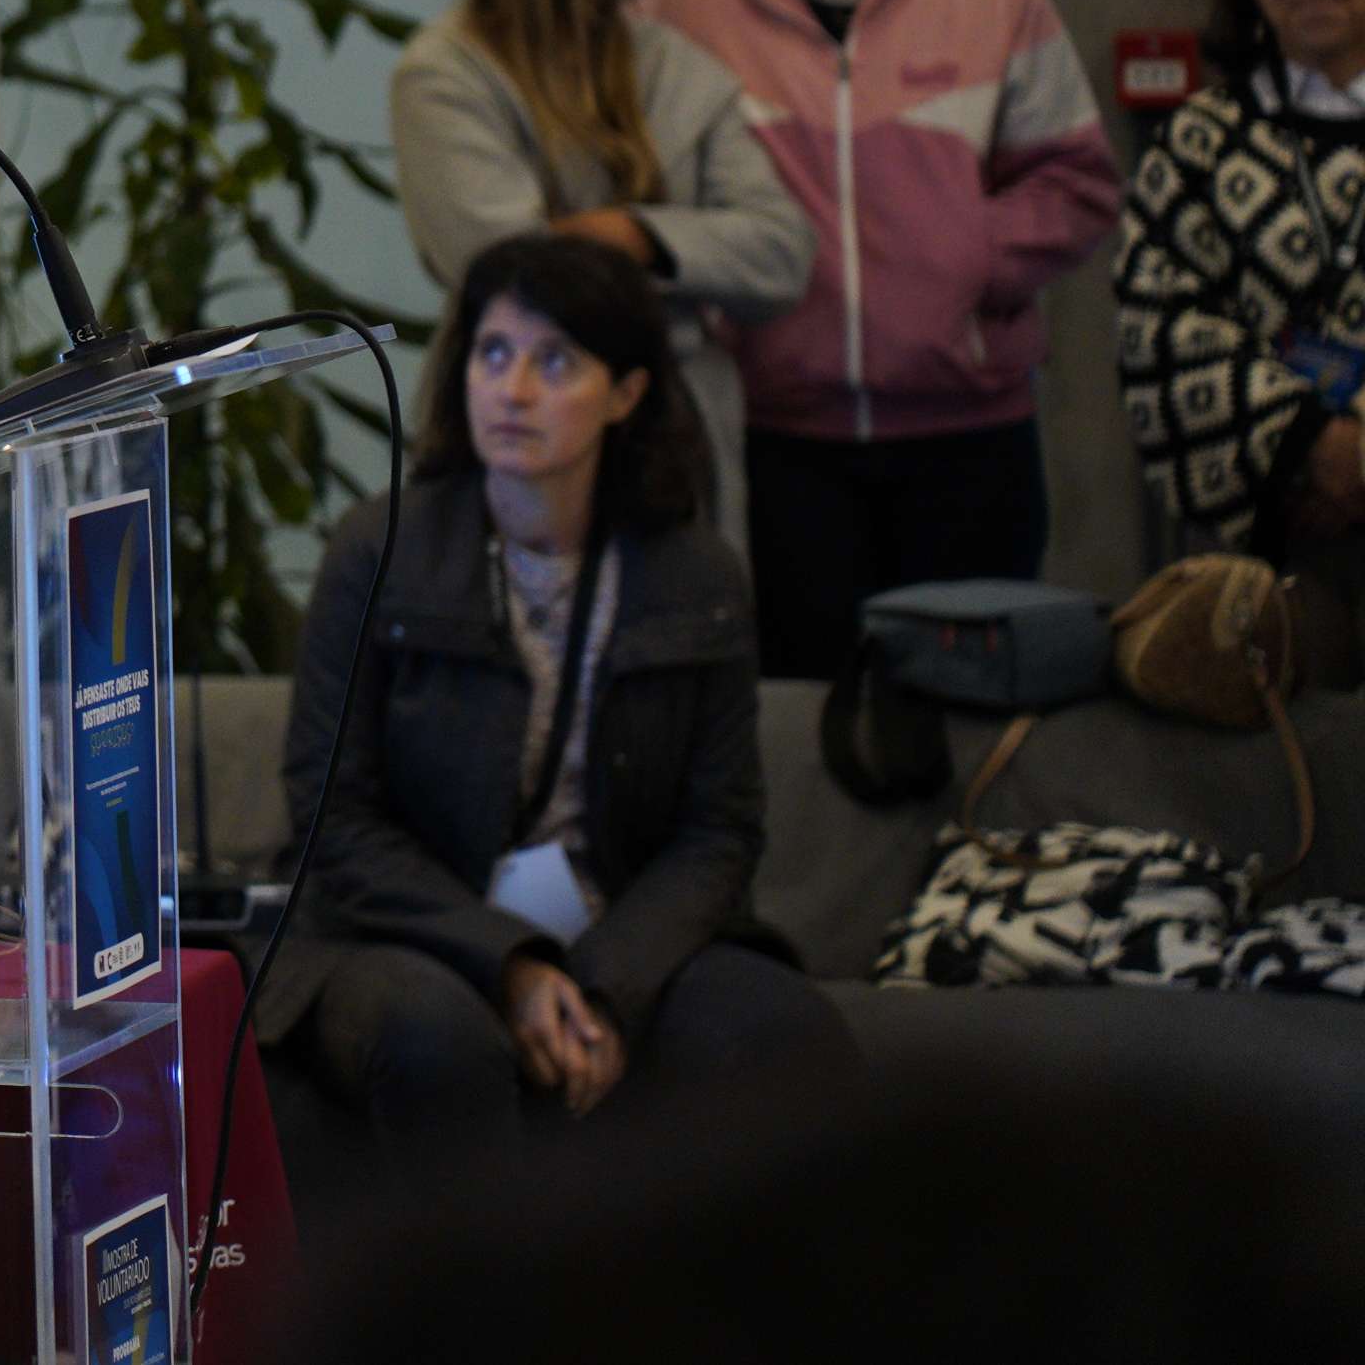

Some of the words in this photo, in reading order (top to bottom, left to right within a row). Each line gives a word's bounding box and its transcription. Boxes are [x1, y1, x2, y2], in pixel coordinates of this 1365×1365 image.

[83, 678, 116, 709] PENSASTE
[115, 672, 133, 696] ONDE
[132, 668, 150, 690] VAIS
[82, 702, 117, 731] DISTRIBUIR
[116, 699, 126, 719] OS
[125, 693, 141, 716] TEUS
[106, 1242, 131, 1272] MOSTRA
[130, 1237, 139, 1260] DE
[97, 1255, 150, 1308] VOLUNTARIADO
[112, 1335, 141, 1364] PROGRAMA
